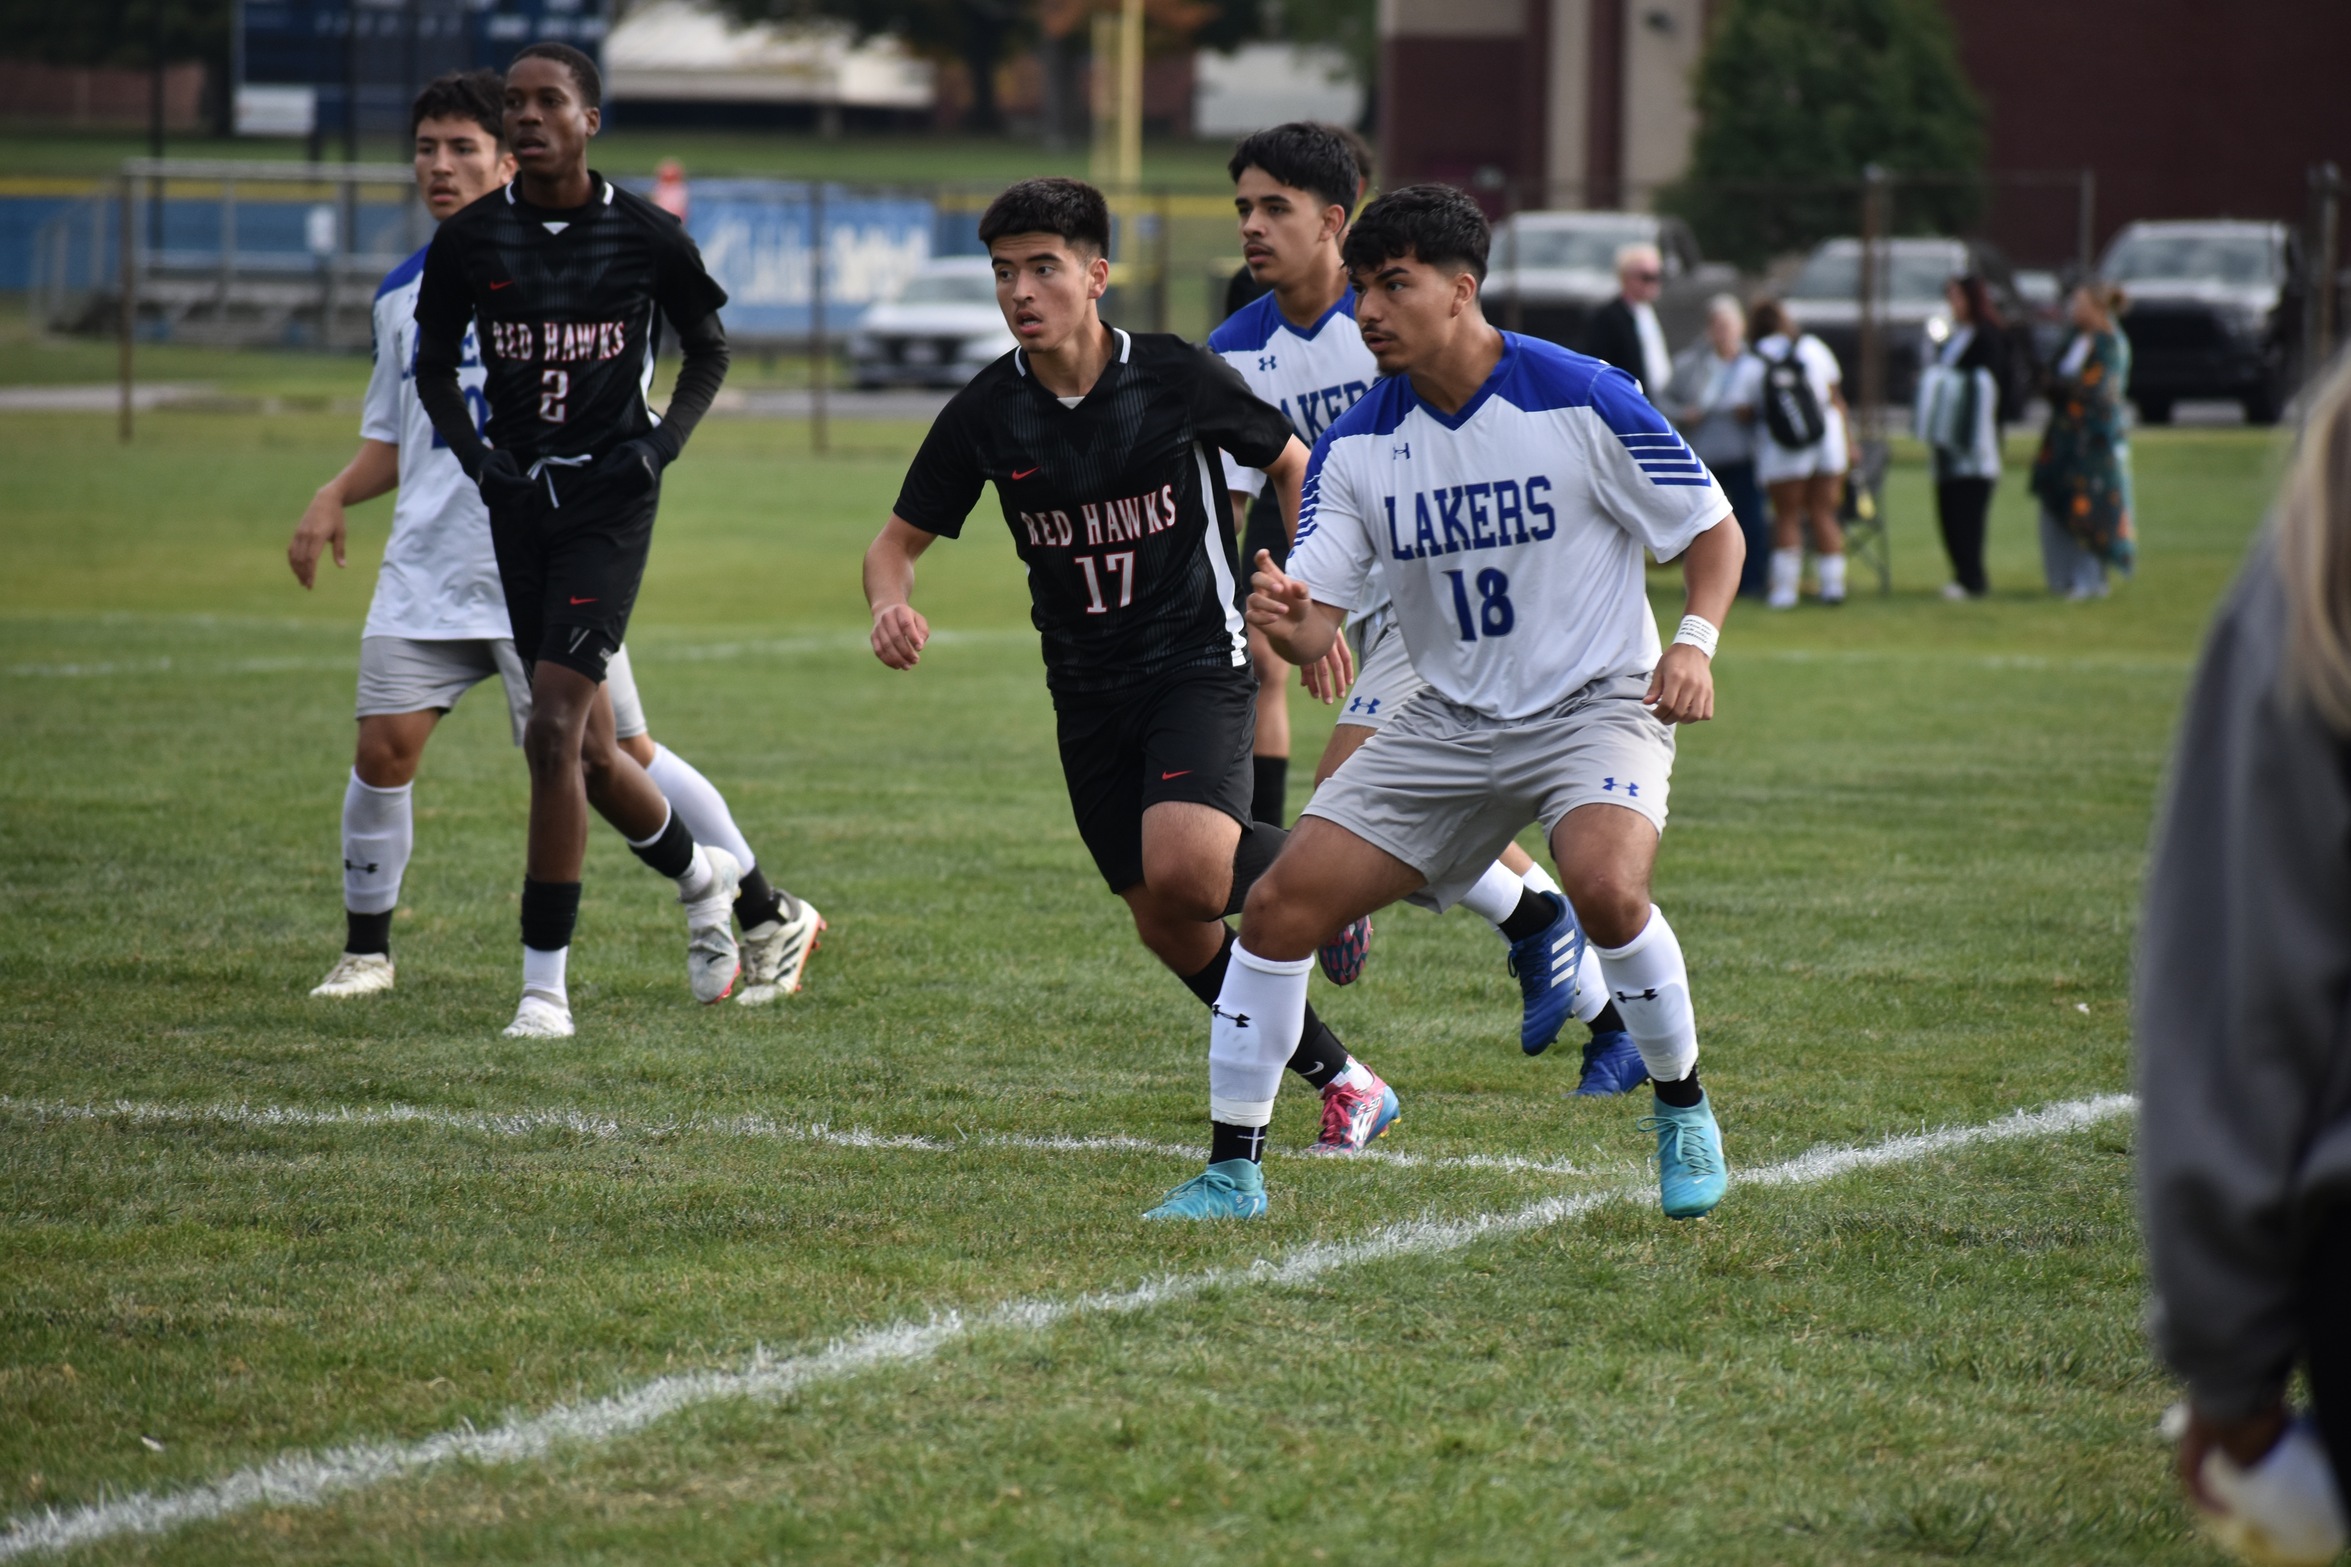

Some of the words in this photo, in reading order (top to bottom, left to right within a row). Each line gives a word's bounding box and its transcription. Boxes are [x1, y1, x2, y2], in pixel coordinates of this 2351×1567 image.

[493, 320, 533, 360] RED
[543, 321, 625, 362] HAWKS
[539, 369, 568, 423] 2
[1020, 510, 1073, 546] RED
[1081, 484, 1176, 546] HAWKS
[1384, 475, 1556, 560] LAKERS
[1074, 551, 1135, 614] 17
[1440, 566, 1515, 642] 18
